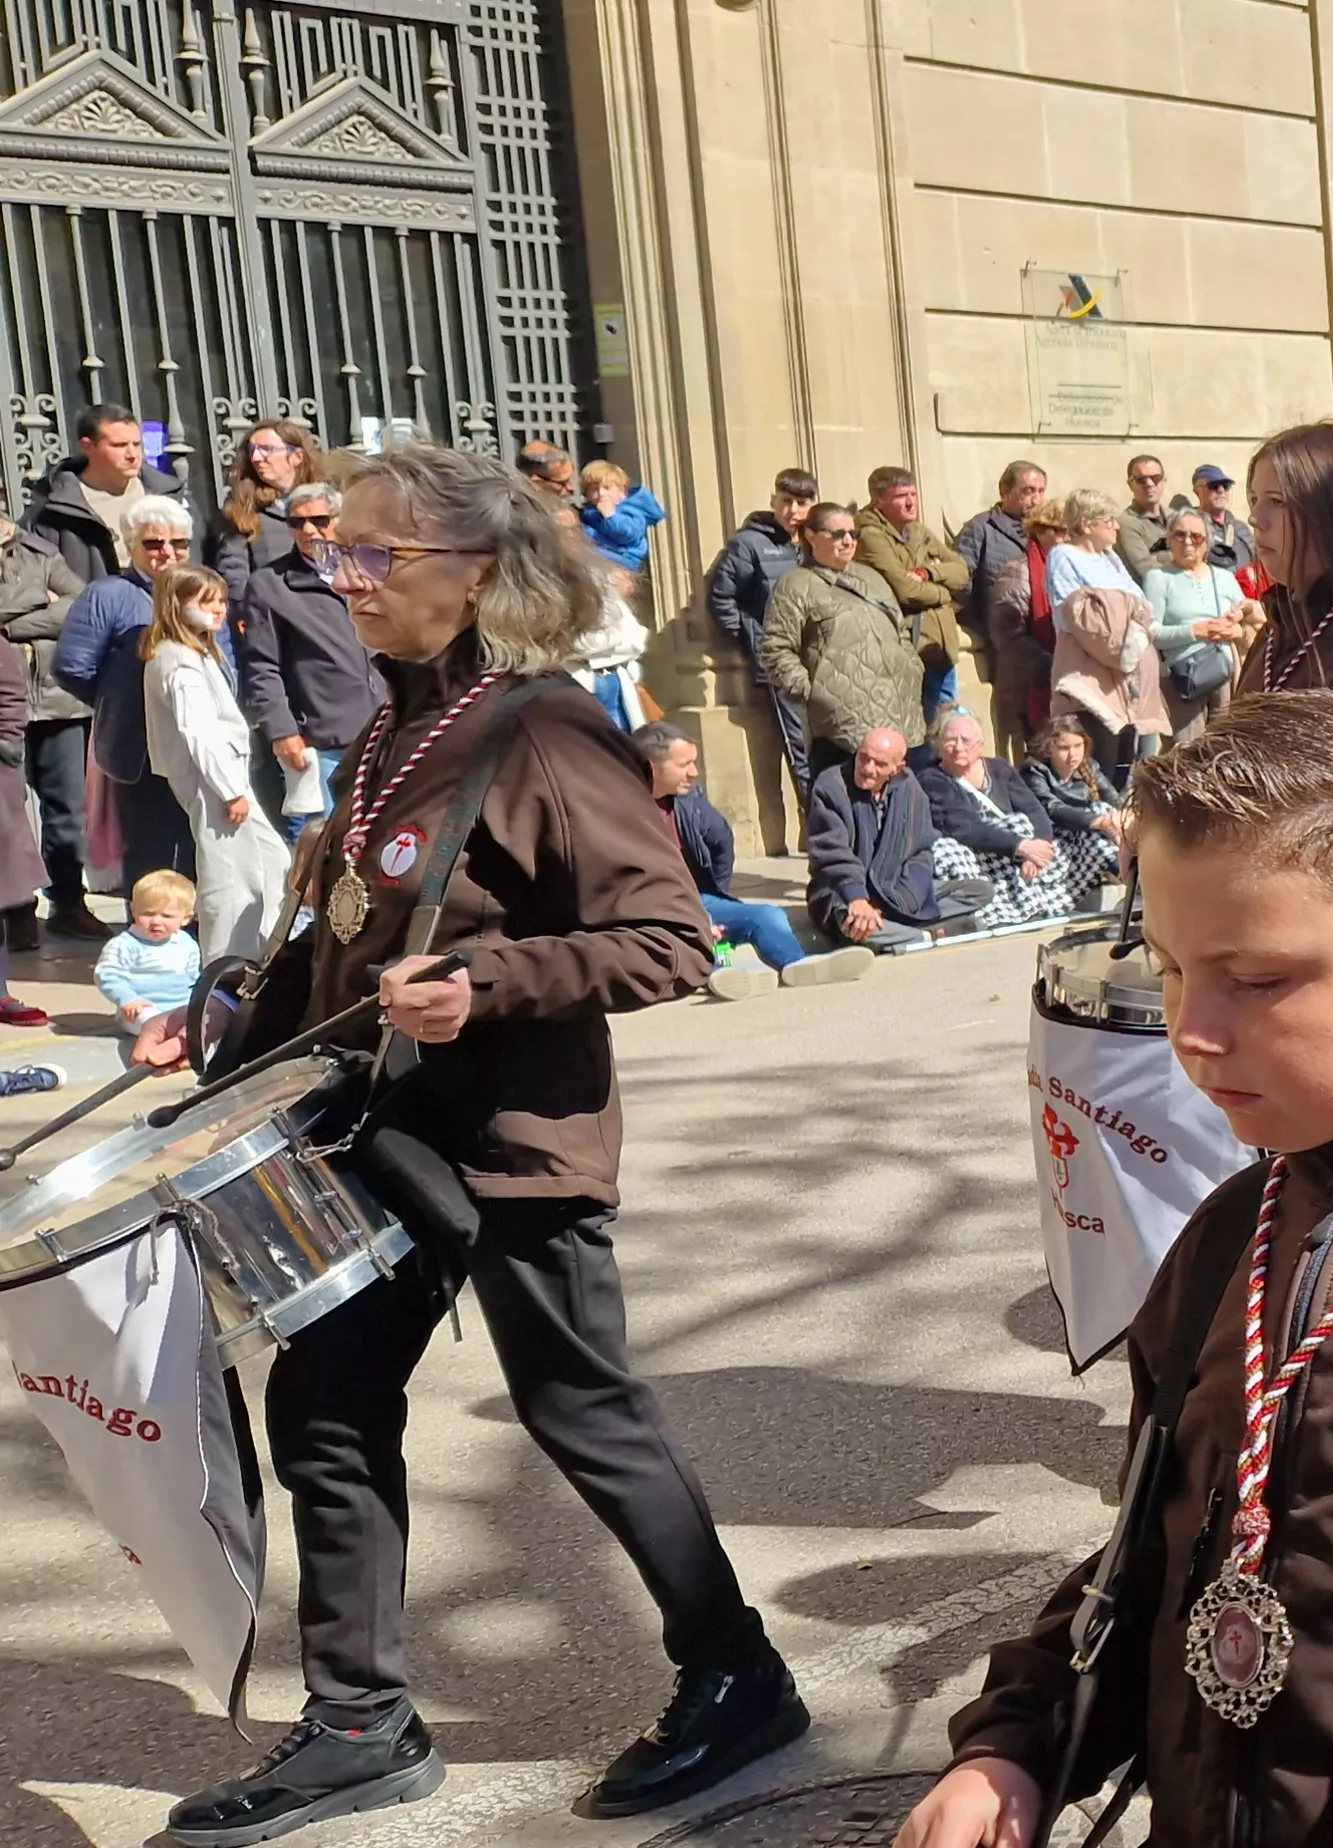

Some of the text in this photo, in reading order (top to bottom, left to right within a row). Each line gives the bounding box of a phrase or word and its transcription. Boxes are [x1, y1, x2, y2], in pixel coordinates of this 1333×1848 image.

[1048, 1076, 1169, 1164] Santiago
[1051, 1187, 1105, 1236] Hsca
[12, 1360, 162, 1442] antiago
